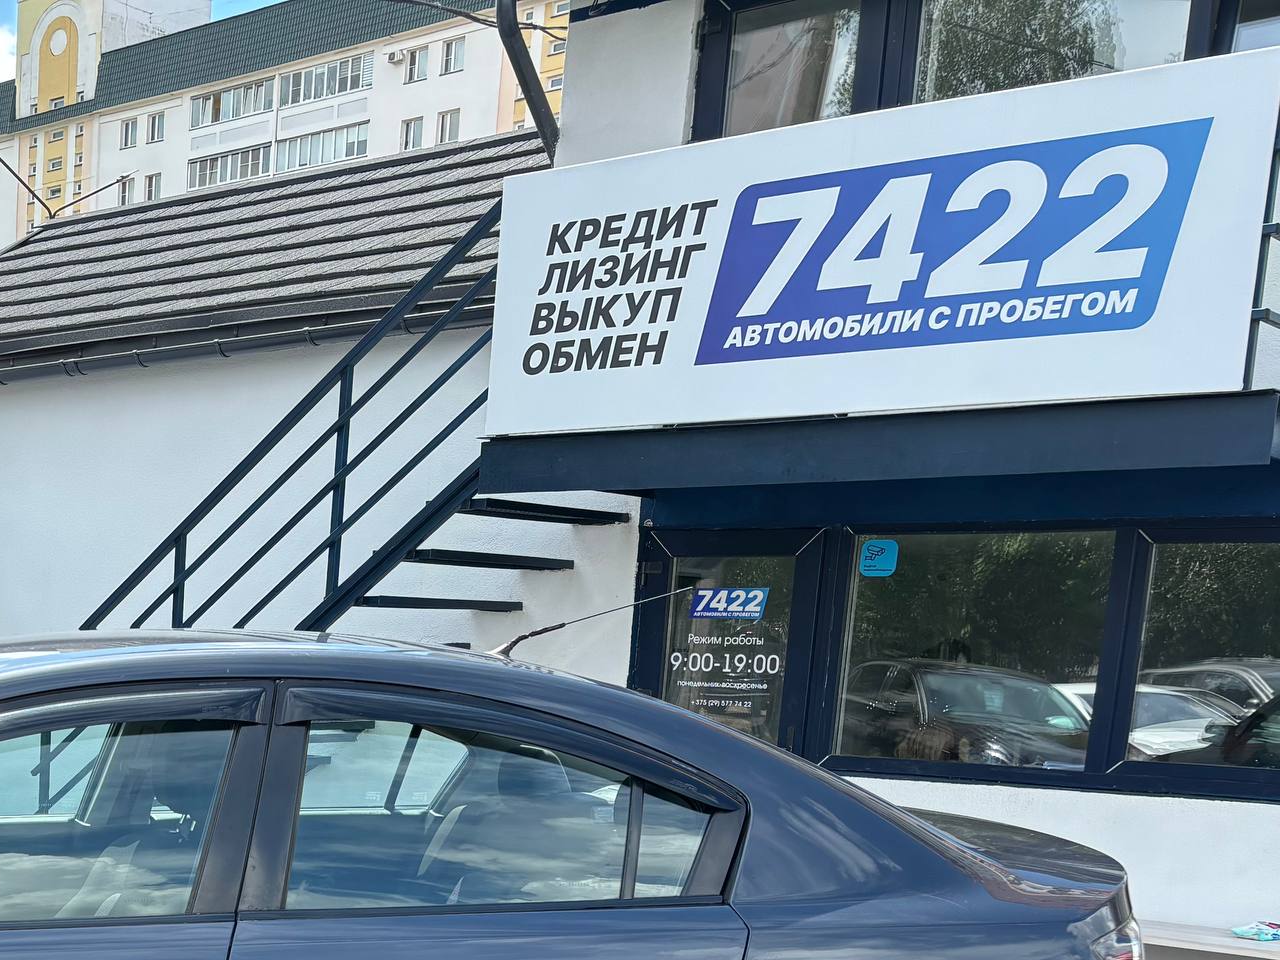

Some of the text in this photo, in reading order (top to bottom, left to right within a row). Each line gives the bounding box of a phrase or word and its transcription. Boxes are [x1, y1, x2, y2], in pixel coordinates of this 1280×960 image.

[546, 199, 719, 256] КРЕДИТ
[736, 143, 1169, 318] 7422
[538, 242, 707, 295] ЛИЗИНГ
[529, 287, 682, 336] ВЫКУП
[723, 287, 1138, 350] АВТОМОБИЛИ С ПРОБЕГОМ
[522, 330, 668, 375] ОБМЕН
[695, 589, 764, 611] 7422
[670, 652, 780, 674] 9:00-19:00
[688, 633, 764, 647] Режим работы
